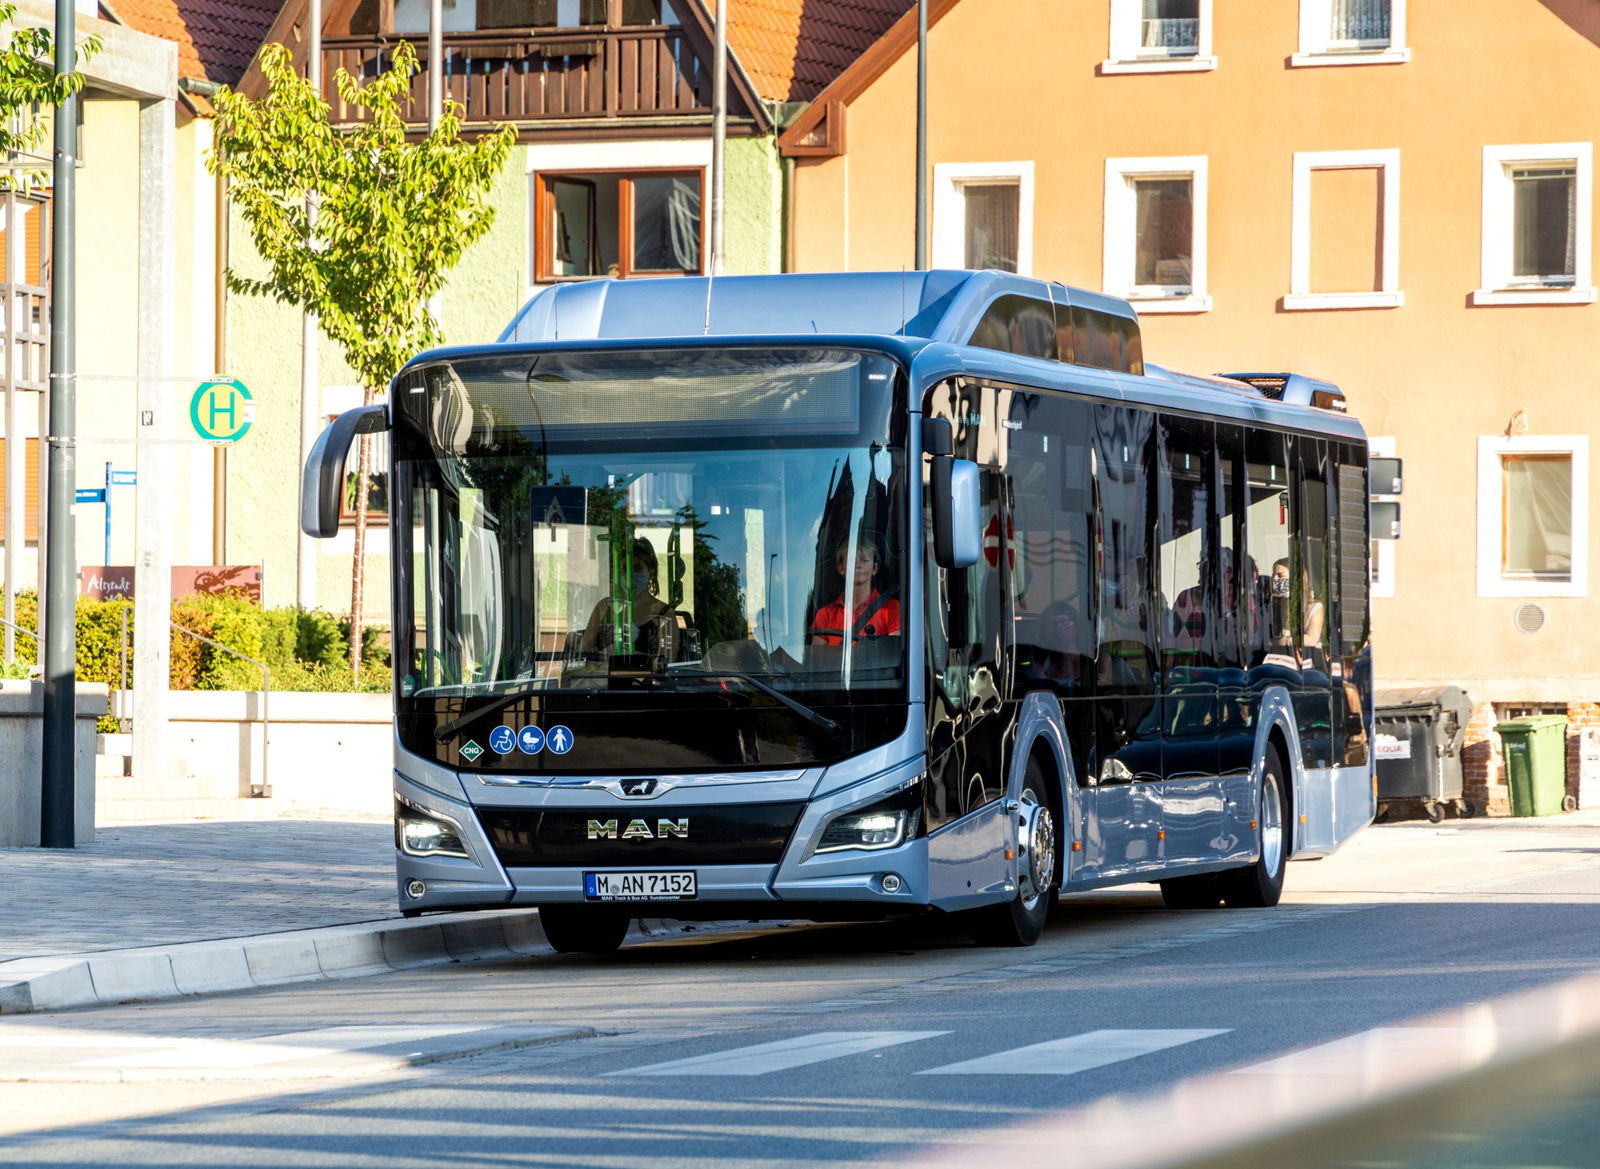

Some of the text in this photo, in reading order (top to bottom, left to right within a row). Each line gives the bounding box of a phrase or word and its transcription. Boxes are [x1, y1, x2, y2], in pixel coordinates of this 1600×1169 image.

[209, 391, 235, 430] H
[587, 818, 689, 839] MAN
[597, 875, 693, 893] M AN 7152
